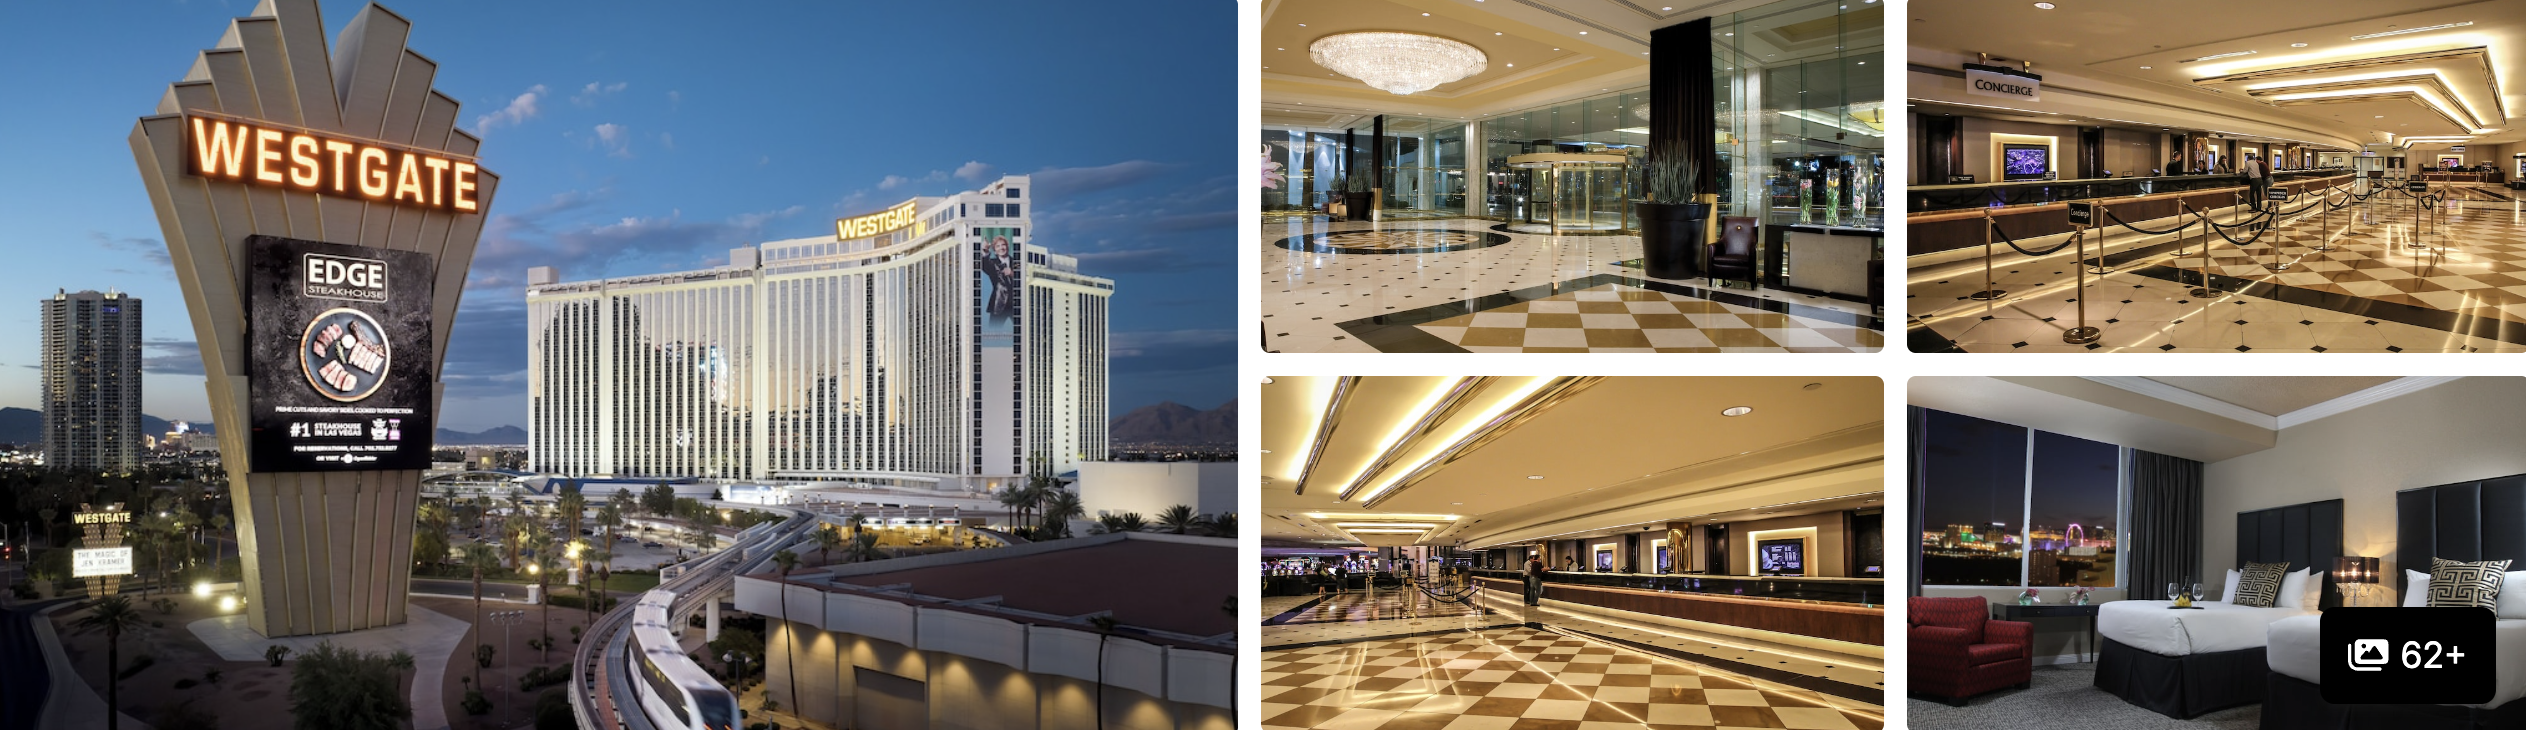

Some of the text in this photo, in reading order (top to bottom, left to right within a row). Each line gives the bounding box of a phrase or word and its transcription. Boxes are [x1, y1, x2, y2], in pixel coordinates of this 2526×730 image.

[1975, 79, 2033, 96] CONCIERGE
[193, 117, 477, 211] WESTGATE
[838, 201, 916, 240] WESTGATE
[2070, 208, 2090, 219] Concierge
[309, 258, 383, 289] EDGE
[308, 285, 384, 300] STEAKHOUSE
[290, 422, 311, 437] #1
[74, 512, 131, 524] WESTGATE
[81, 559, 93, 567] JEN
